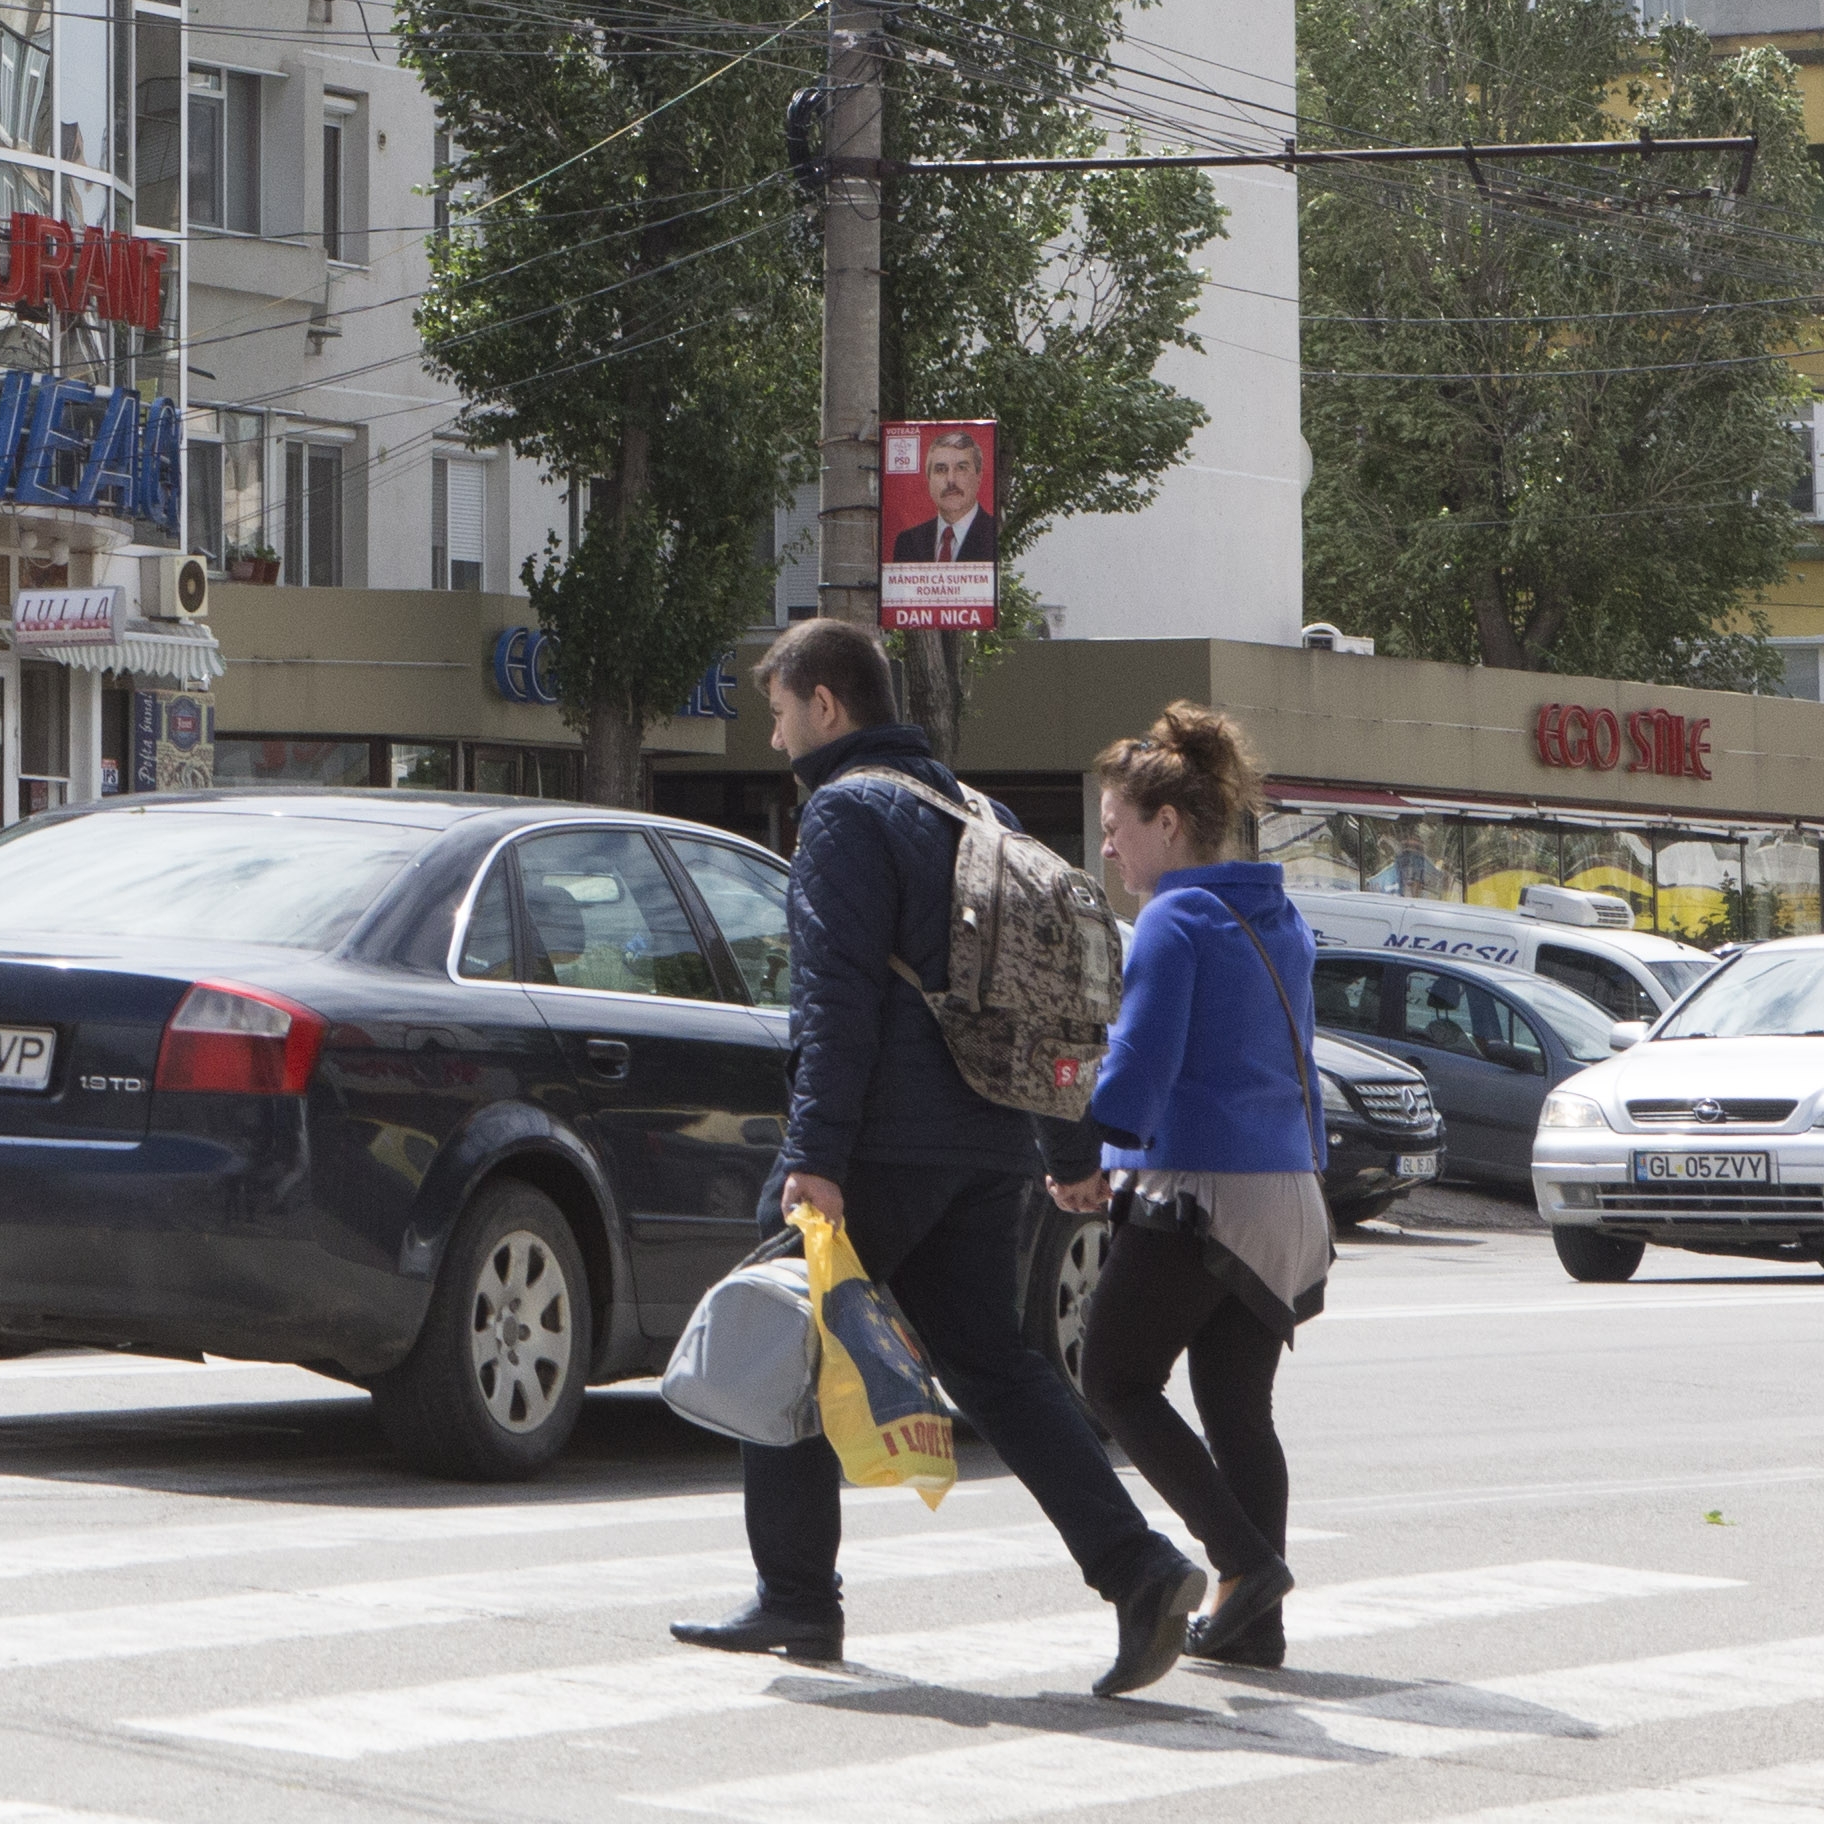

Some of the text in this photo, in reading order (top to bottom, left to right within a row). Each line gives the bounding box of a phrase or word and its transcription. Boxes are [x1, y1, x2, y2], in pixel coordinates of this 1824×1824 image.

[894, 456, 910, 465] PSD
[888, 573, 929, 585] MÂNDRI
[948, 574, 989, 584] SUNTEM
[896, 609, 981, 625] DAN NICA
[1537, 703, 1621, 772] EGO
[1650, 1156, 1678, 1178] GL
